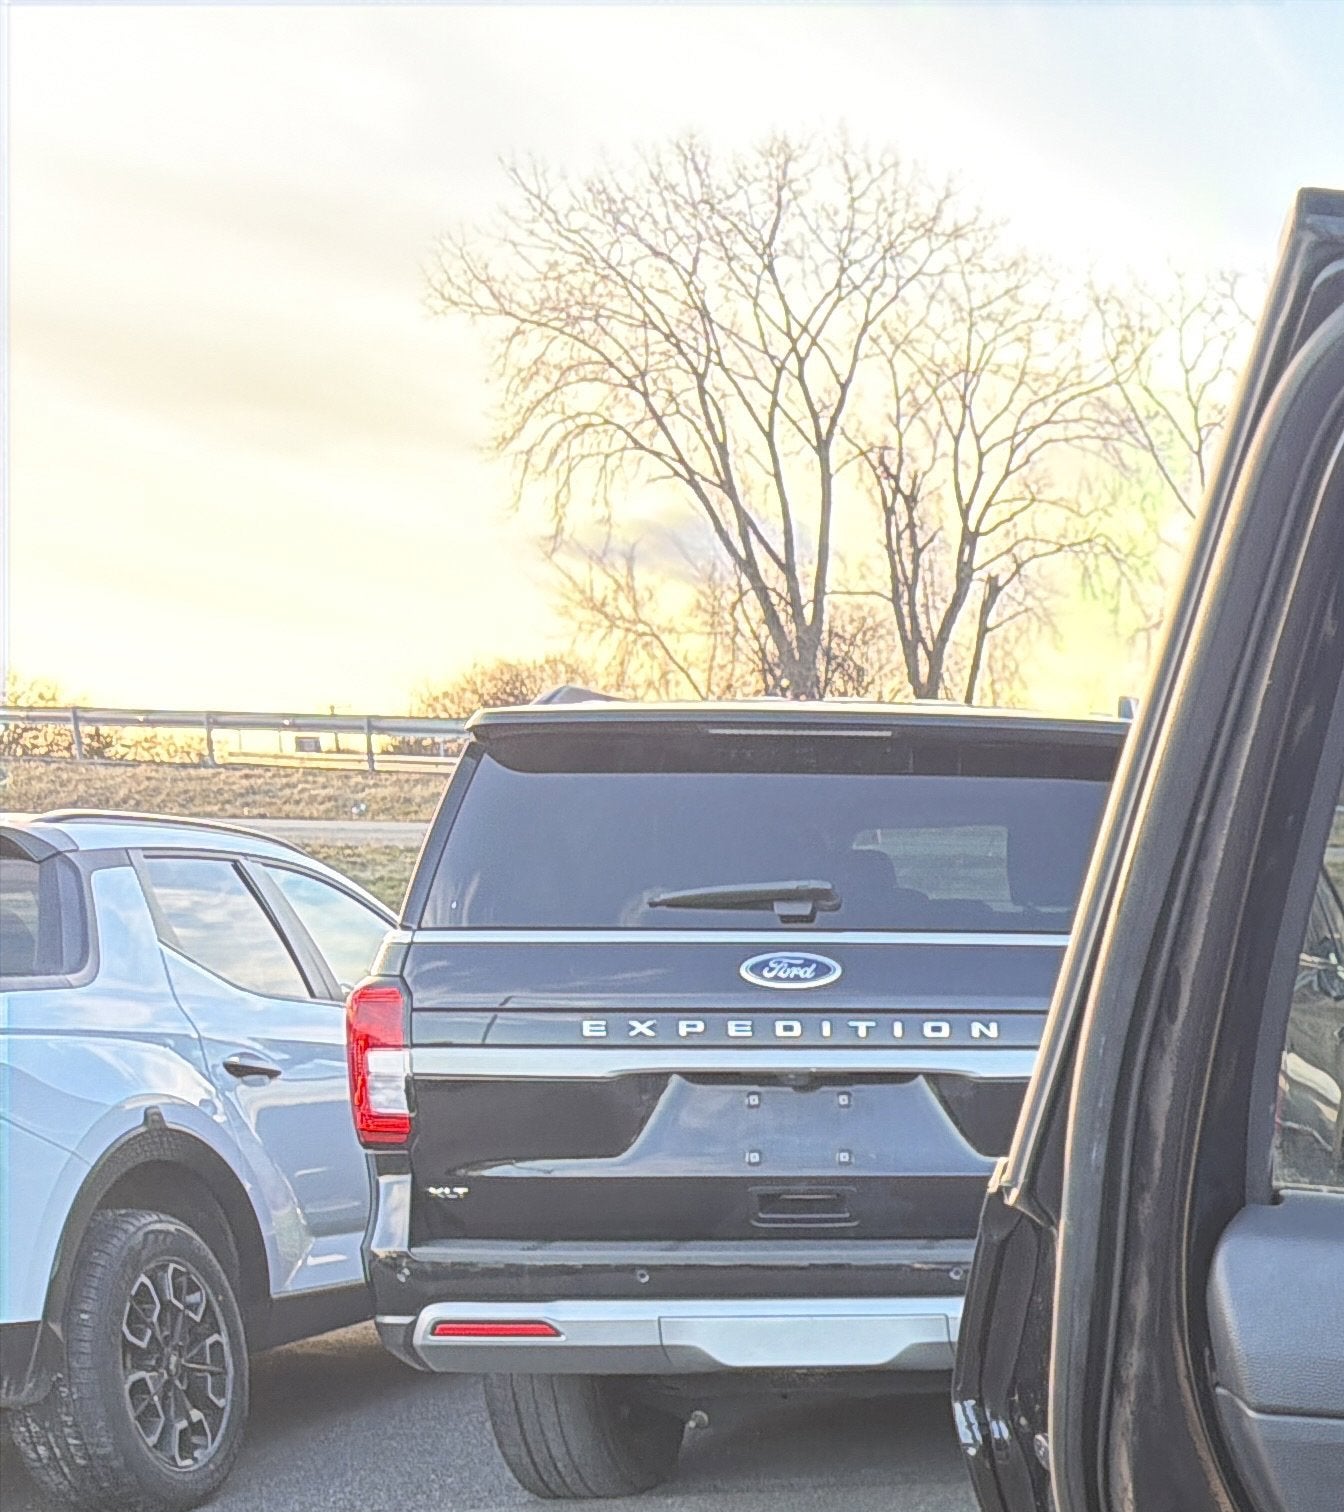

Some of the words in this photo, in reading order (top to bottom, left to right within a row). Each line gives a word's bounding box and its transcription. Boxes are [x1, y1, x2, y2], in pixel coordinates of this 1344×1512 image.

[762, 958, 817, 978] Ford
[582, 1020, 999, 1038] EXPEDITION
[428, 1186, 469, 1199] XLT
